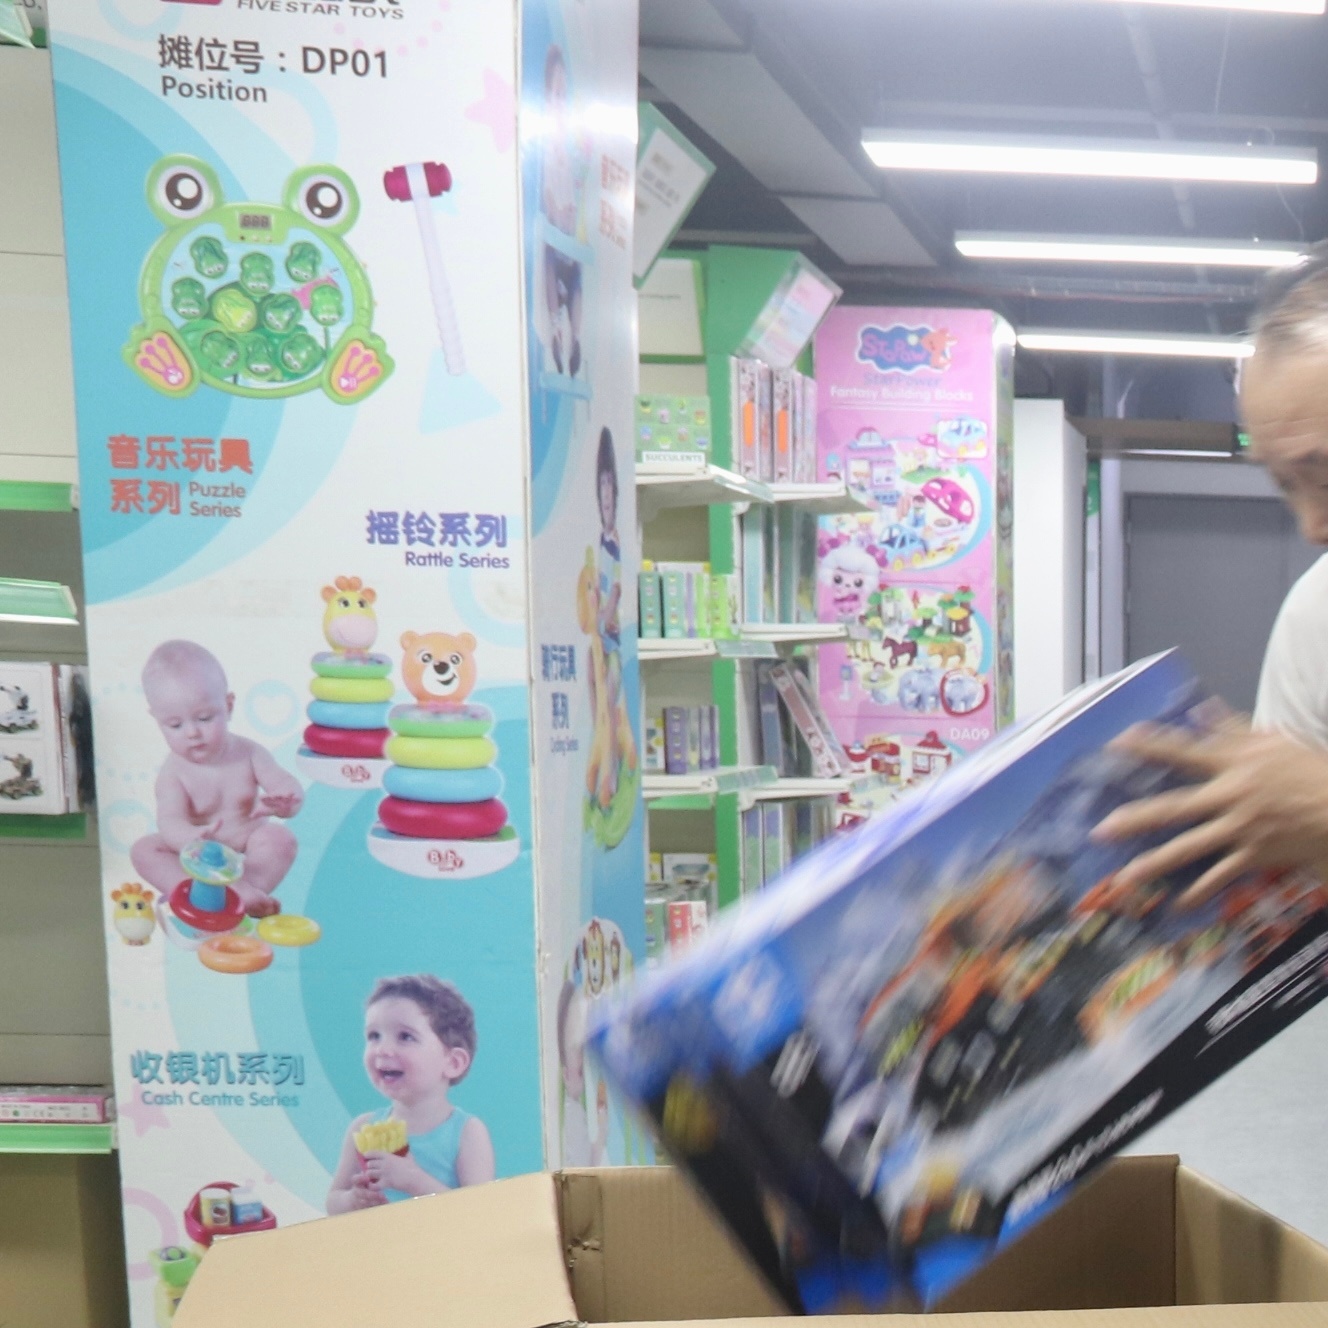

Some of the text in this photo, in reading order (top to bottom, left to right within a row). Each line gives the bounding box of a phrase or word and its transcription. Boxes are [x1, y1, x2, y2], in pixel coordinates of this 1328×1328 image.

[238, 0, 404, 20] FIVE STAR TOYS
[161, 75, 268, 103] Position
[107, 434, 254, 475] 音乐玩具
[109, 478, 181, 516] 系列
[188, 481, 246, 501] Puzzle
[189, 500, 242, 518] Series
[365, 510, 508, 548] 摇铃系列
[404, 550, 510, 570] Rattle Series
[949, 728, 990, 742] DA09
[131, 1050, 304, 1086] 收银机系列
[141, 1091, 299, 1107] Cash Centre Series
